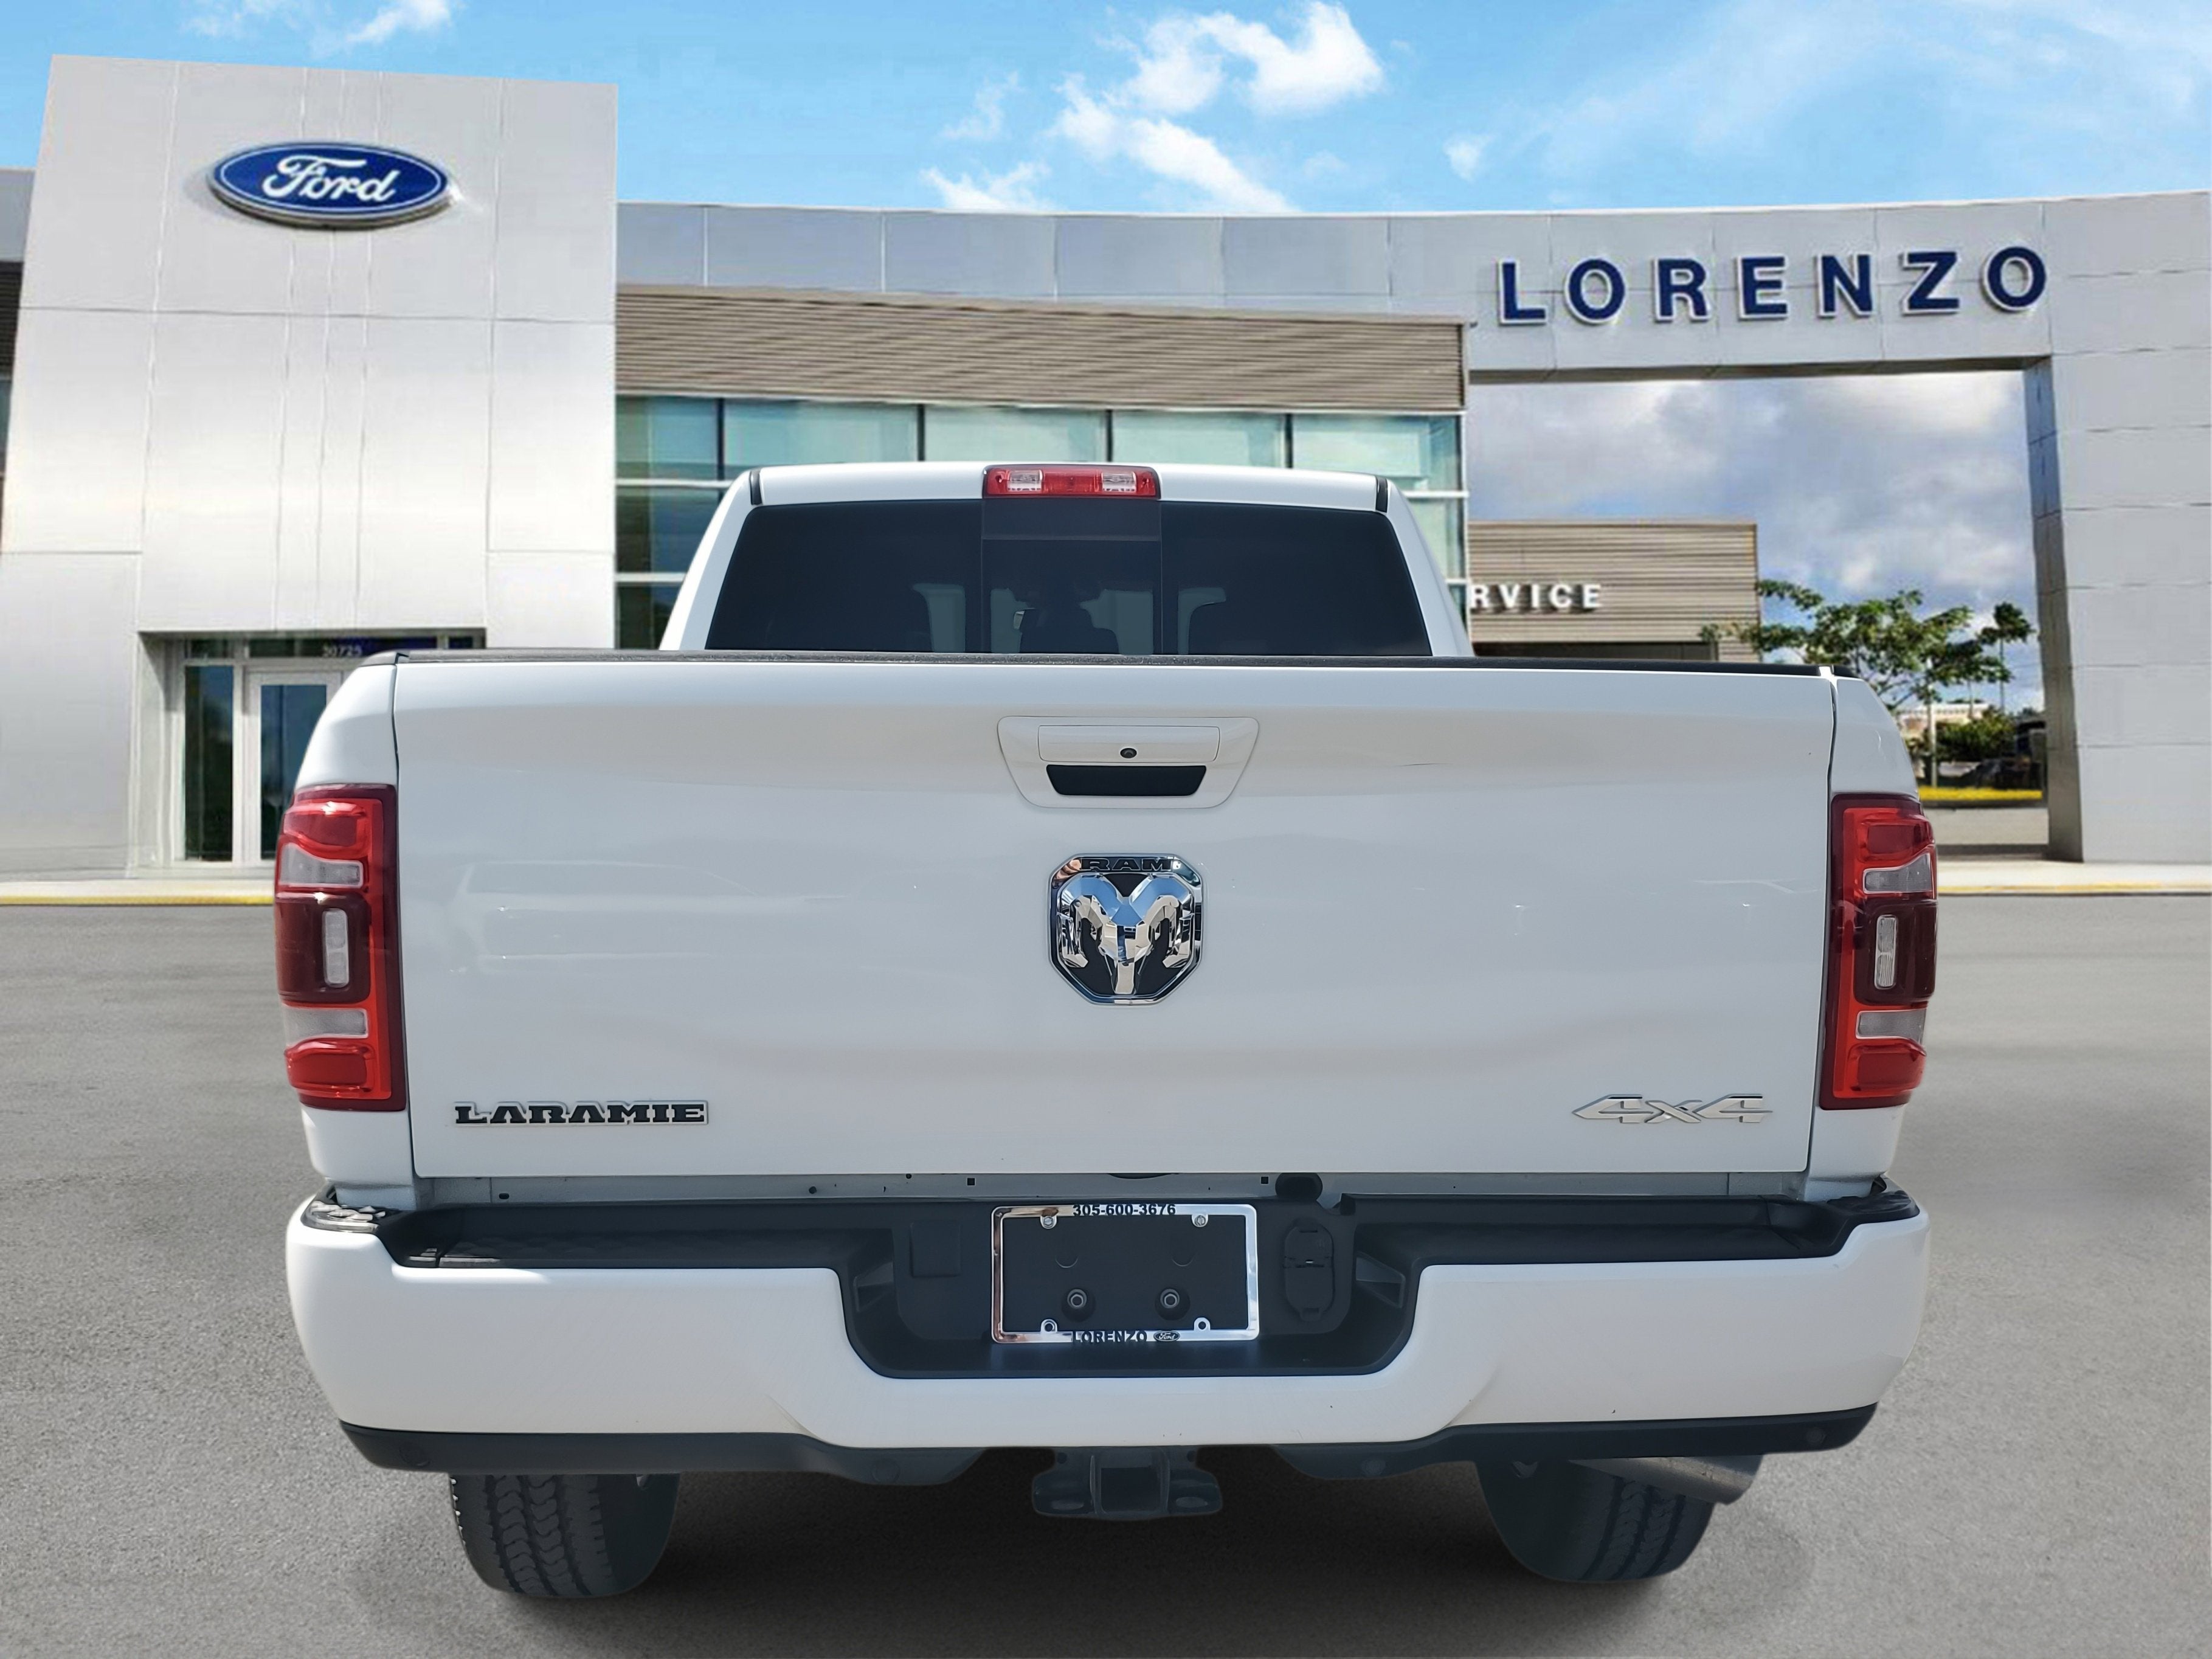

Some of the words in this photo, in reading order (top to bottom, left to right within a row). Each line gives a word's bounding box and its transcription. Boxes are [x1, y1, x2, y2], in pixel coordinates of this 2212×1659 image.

[262, 154, 401, 201] Ford
[1498, 246, 2048, 324] LORENZO
[1080, 857, 1173, 871] RAM
[454, 1101, 708, 1125] LARAMIE
[1073, 1204, 1176, 1216] 305-600-3676
[1072, 1329, 1147, 1343] LORENZO
